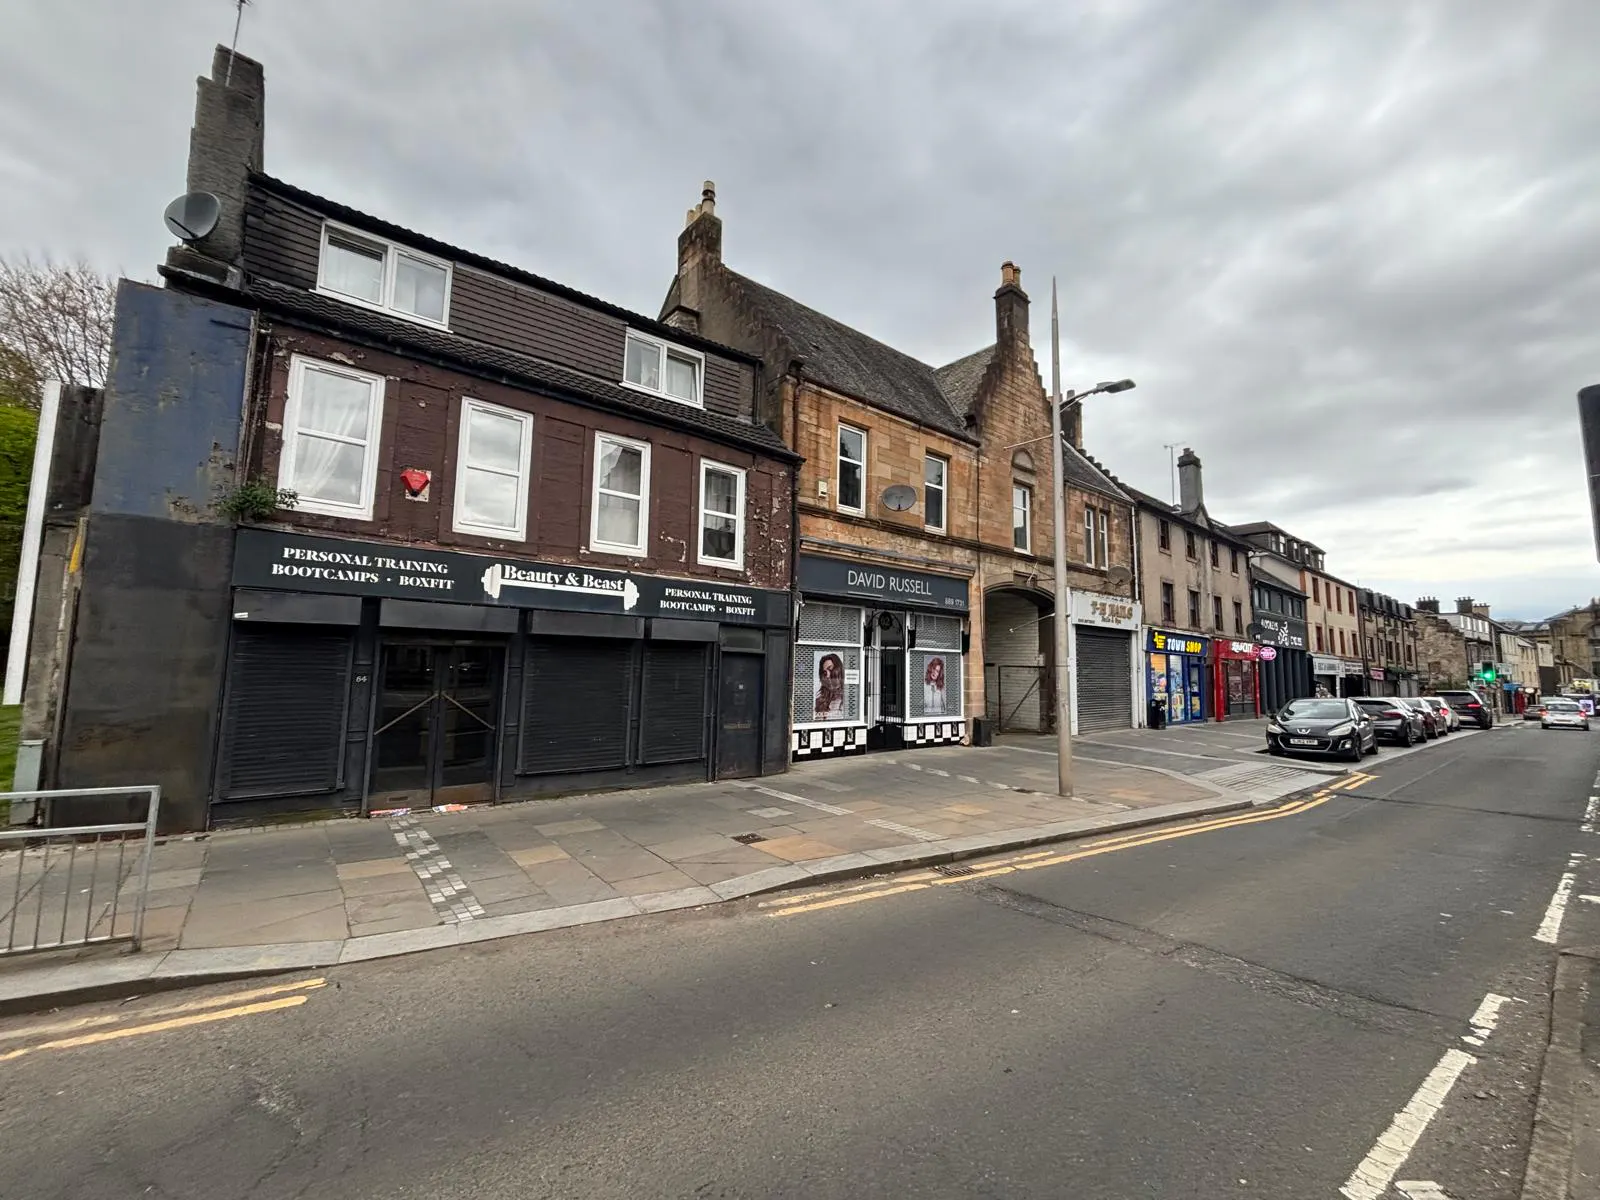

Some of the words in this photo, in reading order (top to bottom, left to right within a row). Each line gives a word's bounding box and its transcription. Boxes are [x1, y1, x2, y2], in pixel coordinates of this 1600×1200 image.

[283, 548, 371, 567] PERSONAL
[374, 557, 448, 574] TRAINING
[272, 564, 379, 583] BOOTCAMPS
[399, 575, 455, 591] BOXFIT
[503, 565, 563, 584] Beauty
[564, 573, 580, 587] &
[583, 574, 624, 591] Beast
[848, 571, 886, 589] DAVID
[889, 577, 932, 595] RUSSELL
[665, 588, 712, 600] PERSONAL
[712, 593, 752, 604] TRAINING
[660, 600, 716, 612] BOOTCAMPS
[725, 605, 756, 616] BOXFIT
[1167, 638, 1186, 652] TOWN
[1186, 640, 1202, 654] SHOP
[355, 675, 368, 683] 64
